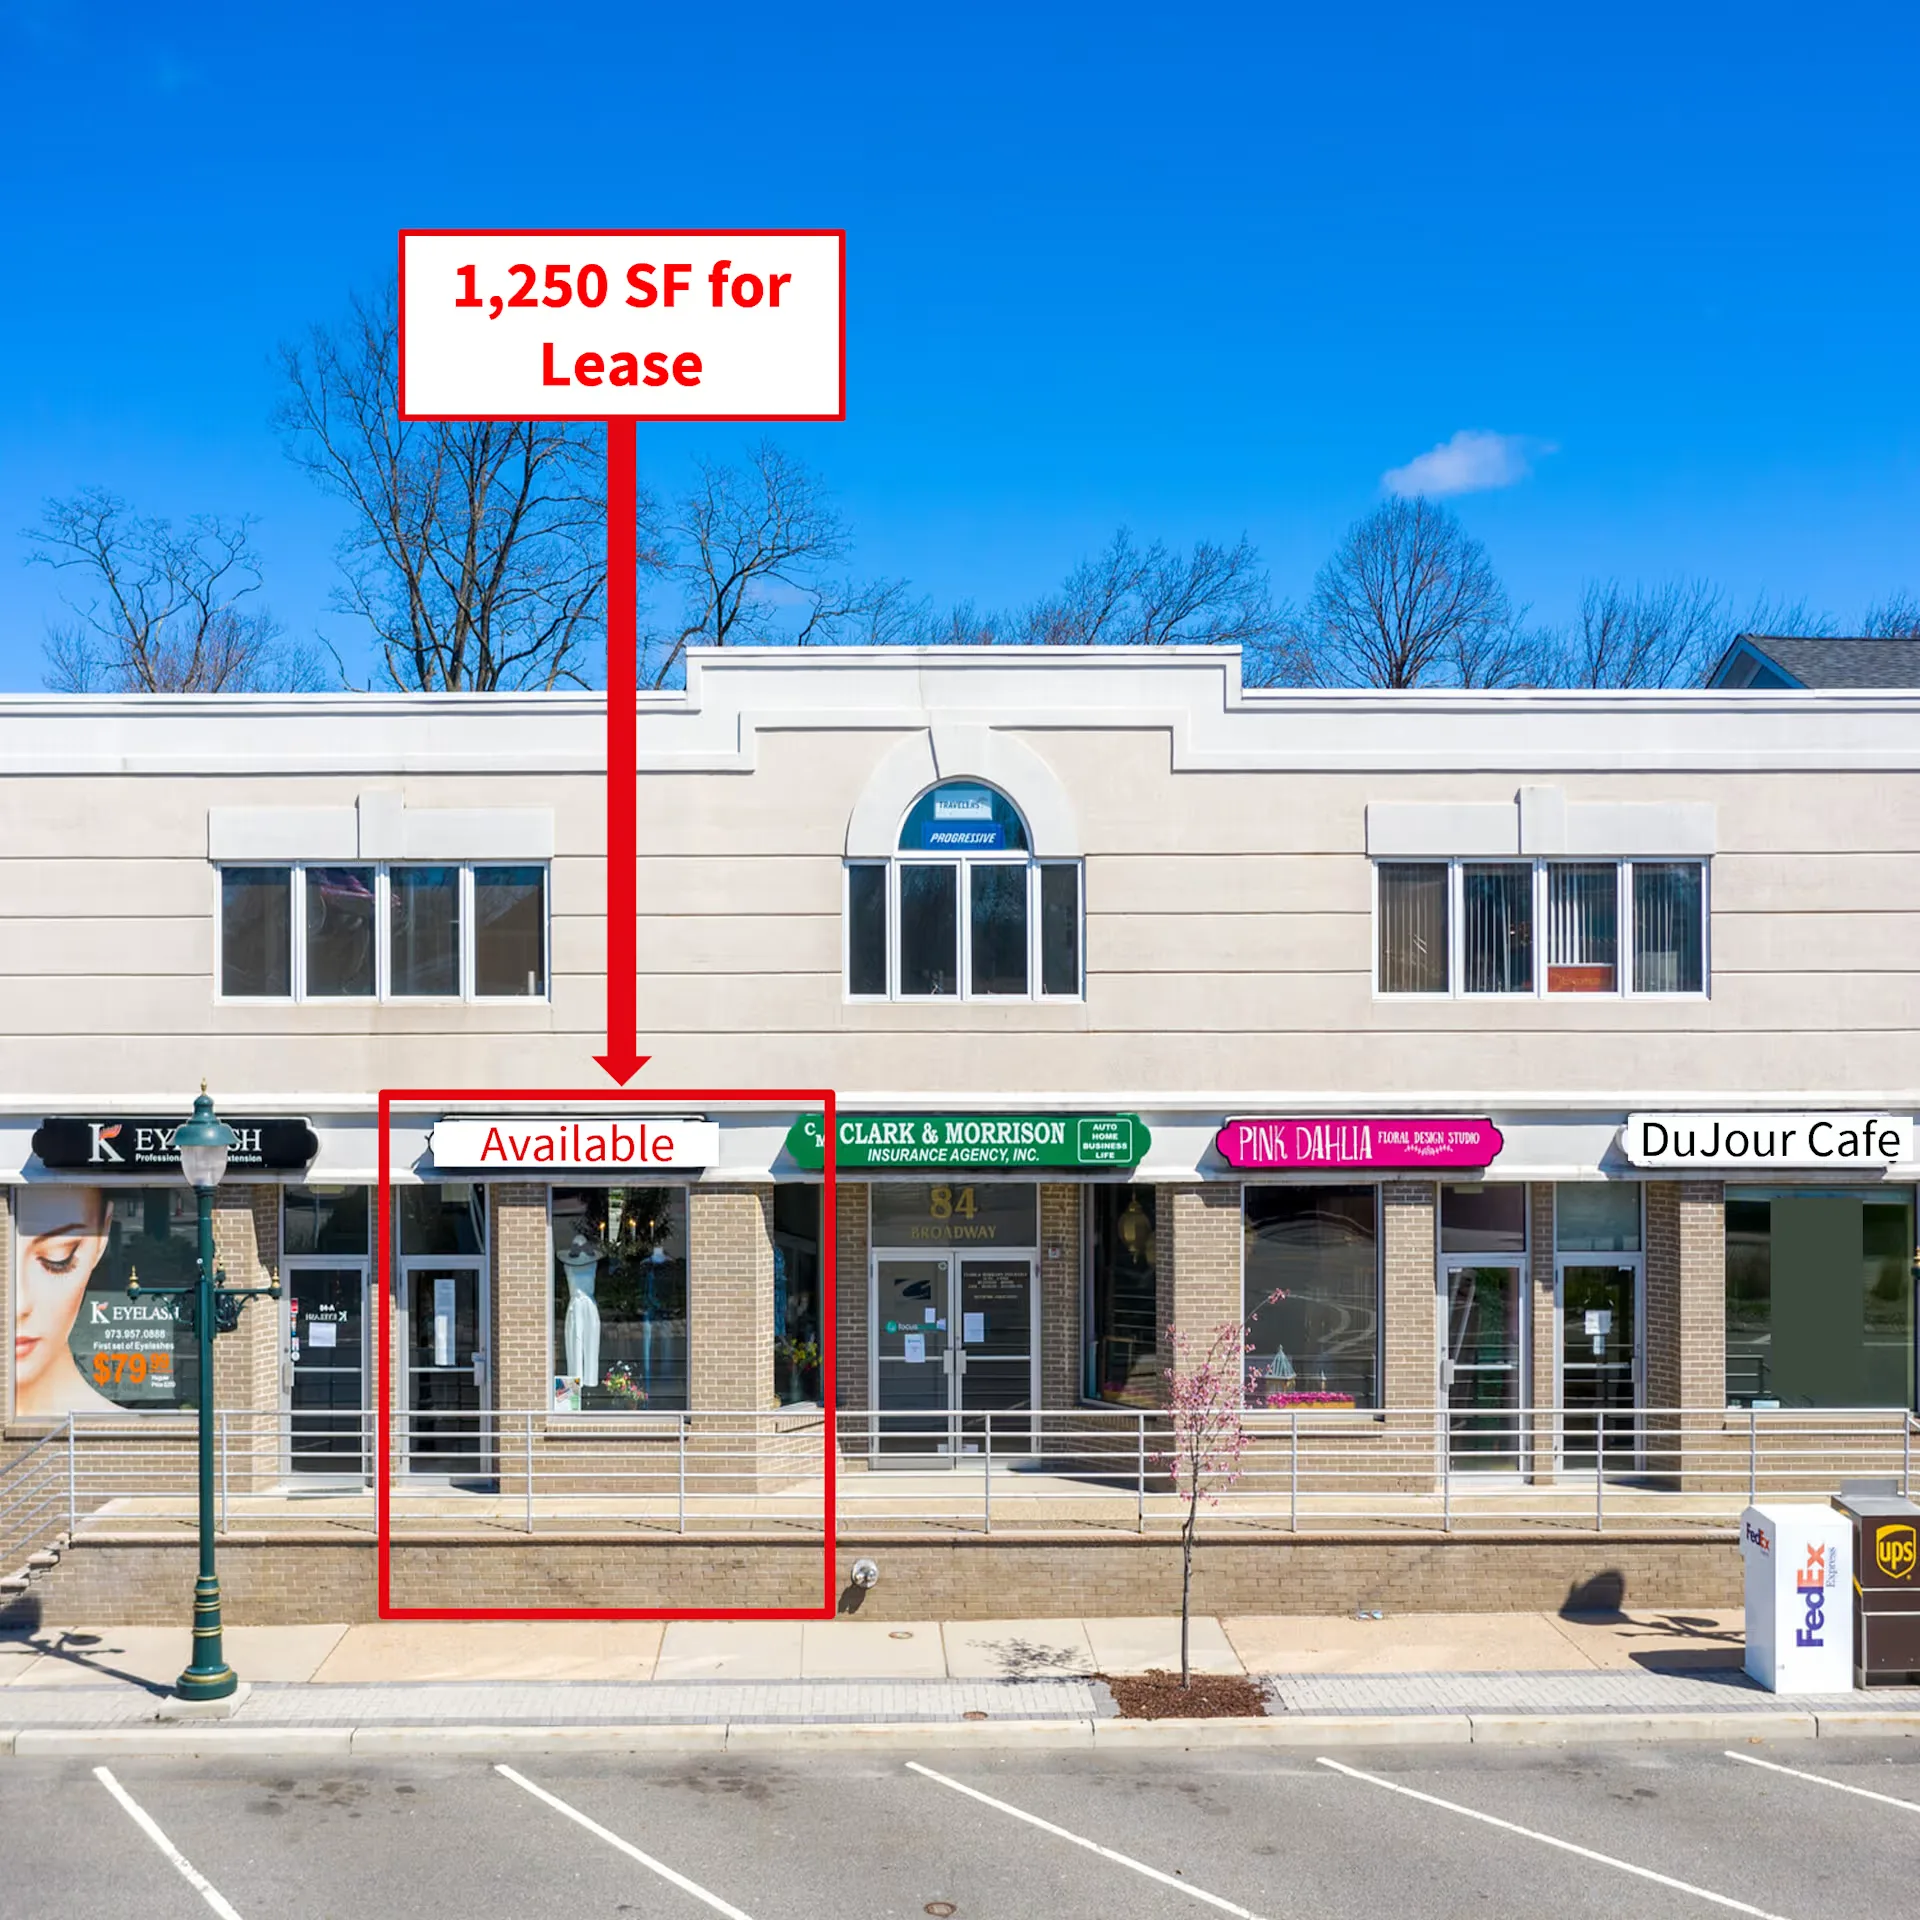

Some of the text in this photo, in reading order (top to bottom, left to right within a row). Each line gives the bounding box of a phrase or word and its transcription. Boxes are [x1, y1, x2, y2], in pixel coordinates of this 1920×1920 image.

[930, 832, 997, 843] PROGRESSIVE
[839, 1122, 1066, 1145] CLARK & MORRISON
[1091, 1132, 1119, 1141] HOME
[1092, 1123, 1118, 1131] AUTO
[1377, 1131, 1481, 1145] FLORAL DESIGN STUDIO
[88, 1123, 125, 1162] K
[1082, 1142, 1128, 1150] BUSINESS
[1239, 1124, 1373, 1162] PINK DAHLIA
[867, 1148, 1040, 1164] INSURANCE AGENCY, INC.
[1095, 1151, 1115, 1159] LIFE
[929, 1186, 978, 1220] 84
[911, 1226, 996, 1239] BROADWAY
[93, 1351, 147, 1388] $79
[1746, 1522, 1770, 1550] FedEx
[1879, 1540, 1914, 1570] ups
[1825, 1546, 1838, 1589] Express
[1796, 1543, 1825, 1648] FedEx
